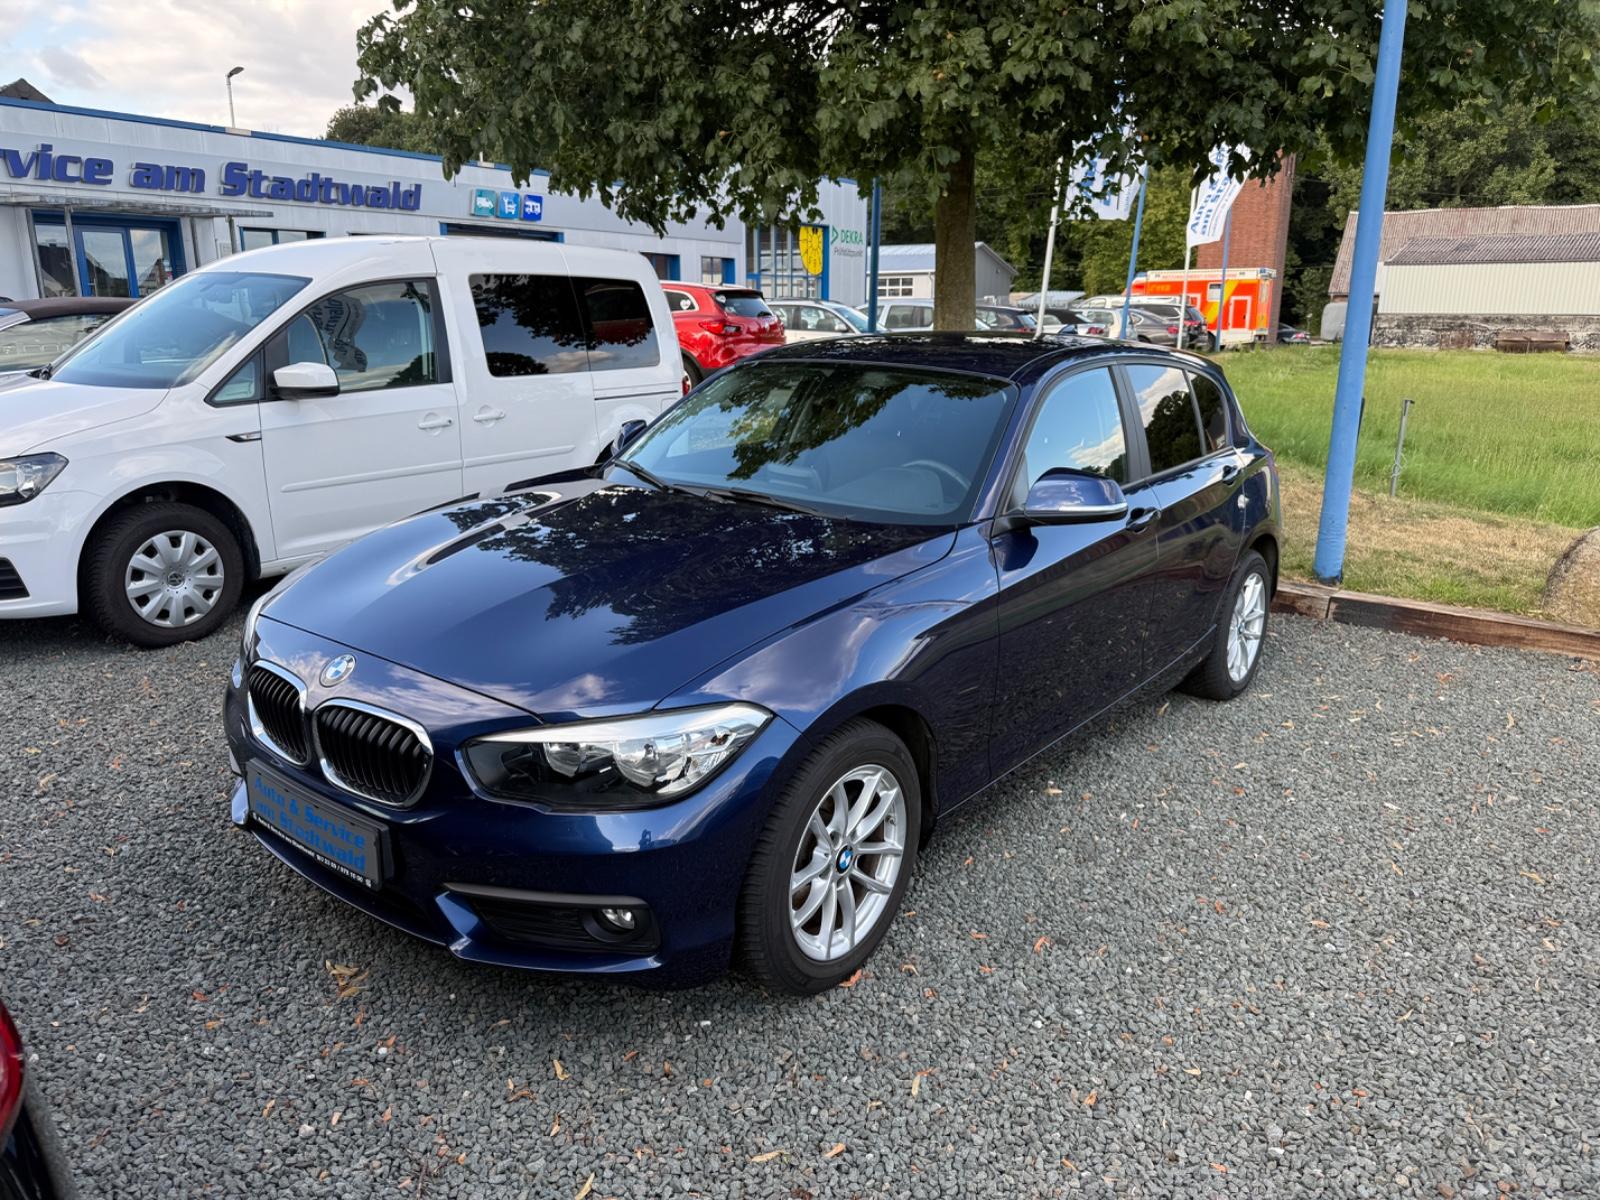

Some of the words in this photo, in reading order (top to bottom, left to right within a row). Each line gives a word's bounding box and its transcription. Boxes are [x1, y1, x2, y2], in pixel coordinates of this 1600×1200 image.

[0, 143, 113, 185] vice
[129, 161, 206, 193] am
[219, 161, 422, 211] Stadtwald
[840, 229, 863, 245] DEKRA
[255, 776, 285, 808] Auto
[304, 805, 366, 848] Service
[255, 802, 275, 822] am
[279, 810, 366, 873] Stadtwald
